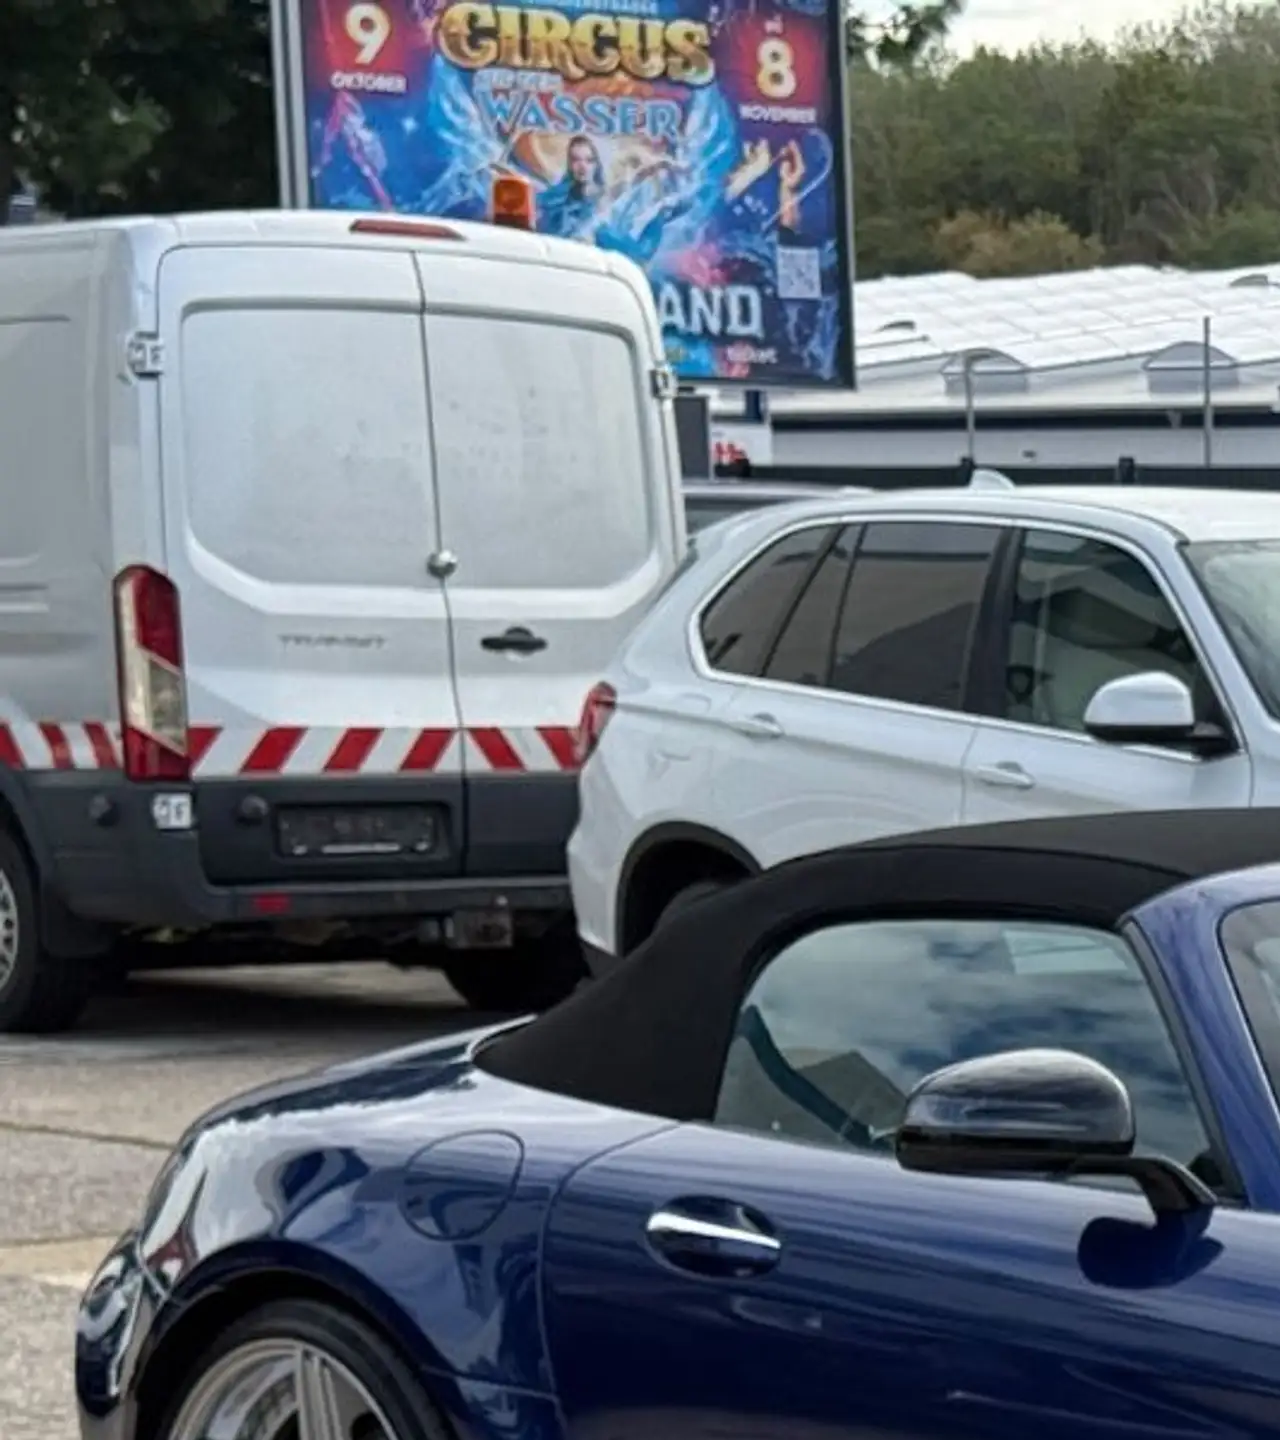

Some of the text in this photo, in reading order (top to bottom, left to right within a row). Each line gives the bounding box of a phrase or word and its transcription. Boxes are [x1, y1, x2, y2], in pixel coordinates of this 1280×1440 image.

[345, 3, 391, 65] 9
[438, 2, 717, 86] CIRCUS
[331, 71, 407, 93] OKTOBER
[756, 37, 796, 98] 8
[474, 88, 683, 138] WASSER
[739, 104, 816, 123] NOVEMBER
[659, 282, 763, 340] AND
